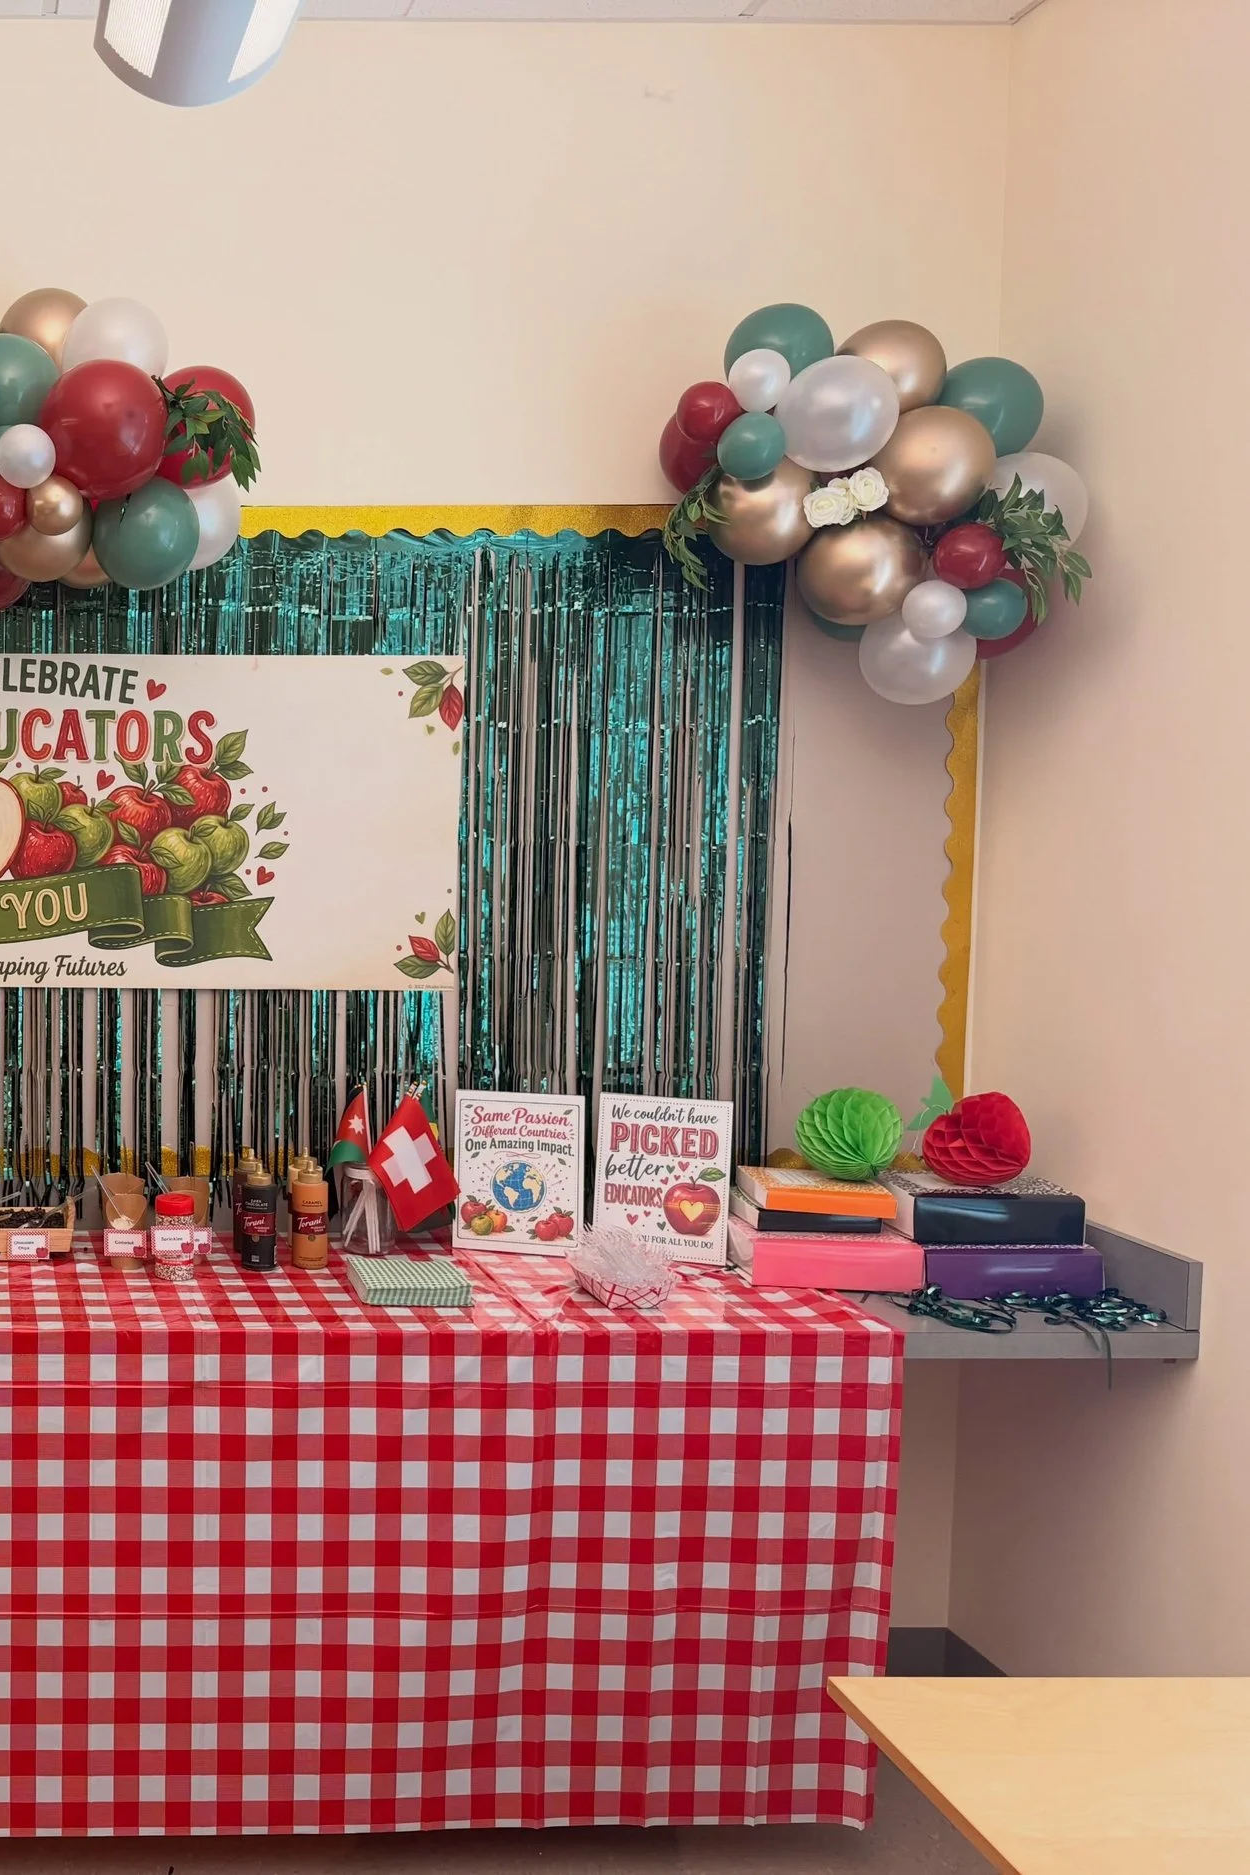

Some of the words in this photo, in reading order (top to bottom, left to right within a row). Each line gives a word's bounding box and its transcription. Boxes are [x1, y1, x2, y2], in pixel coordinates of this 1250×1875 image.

[0, 882, 89, 930] YOU
[54, 954, 127, 976] Futures
[471, 1105, 511, 1126] Same
[611, 1103, 632, 1120] We
[634, 1105, 685, 1124] couldn't
[686, 1107, 719, 1124] have
[472, 1125, 517, 1140] Different
[609, 1121, 720, 1160] PICKED
[465, 1139, 486, 1152] One
[489, 1138, 534, 1154] Amazing
[537, 1139, 575, 1158] Impact.
[604, 1153, 666, 1181] better
[604, 1182, 663, 1209] EDUCATORS
[243, 1216, 265, 1230] Torani
[298, 1216, 322, 1230] Torani
[651, 1235, 667, 1245] FOR
[668, 1237, 683, 1247] ALL
[684, 1238, 700, 1248] YOU
[700, 1240, 714, 1250] DO!
